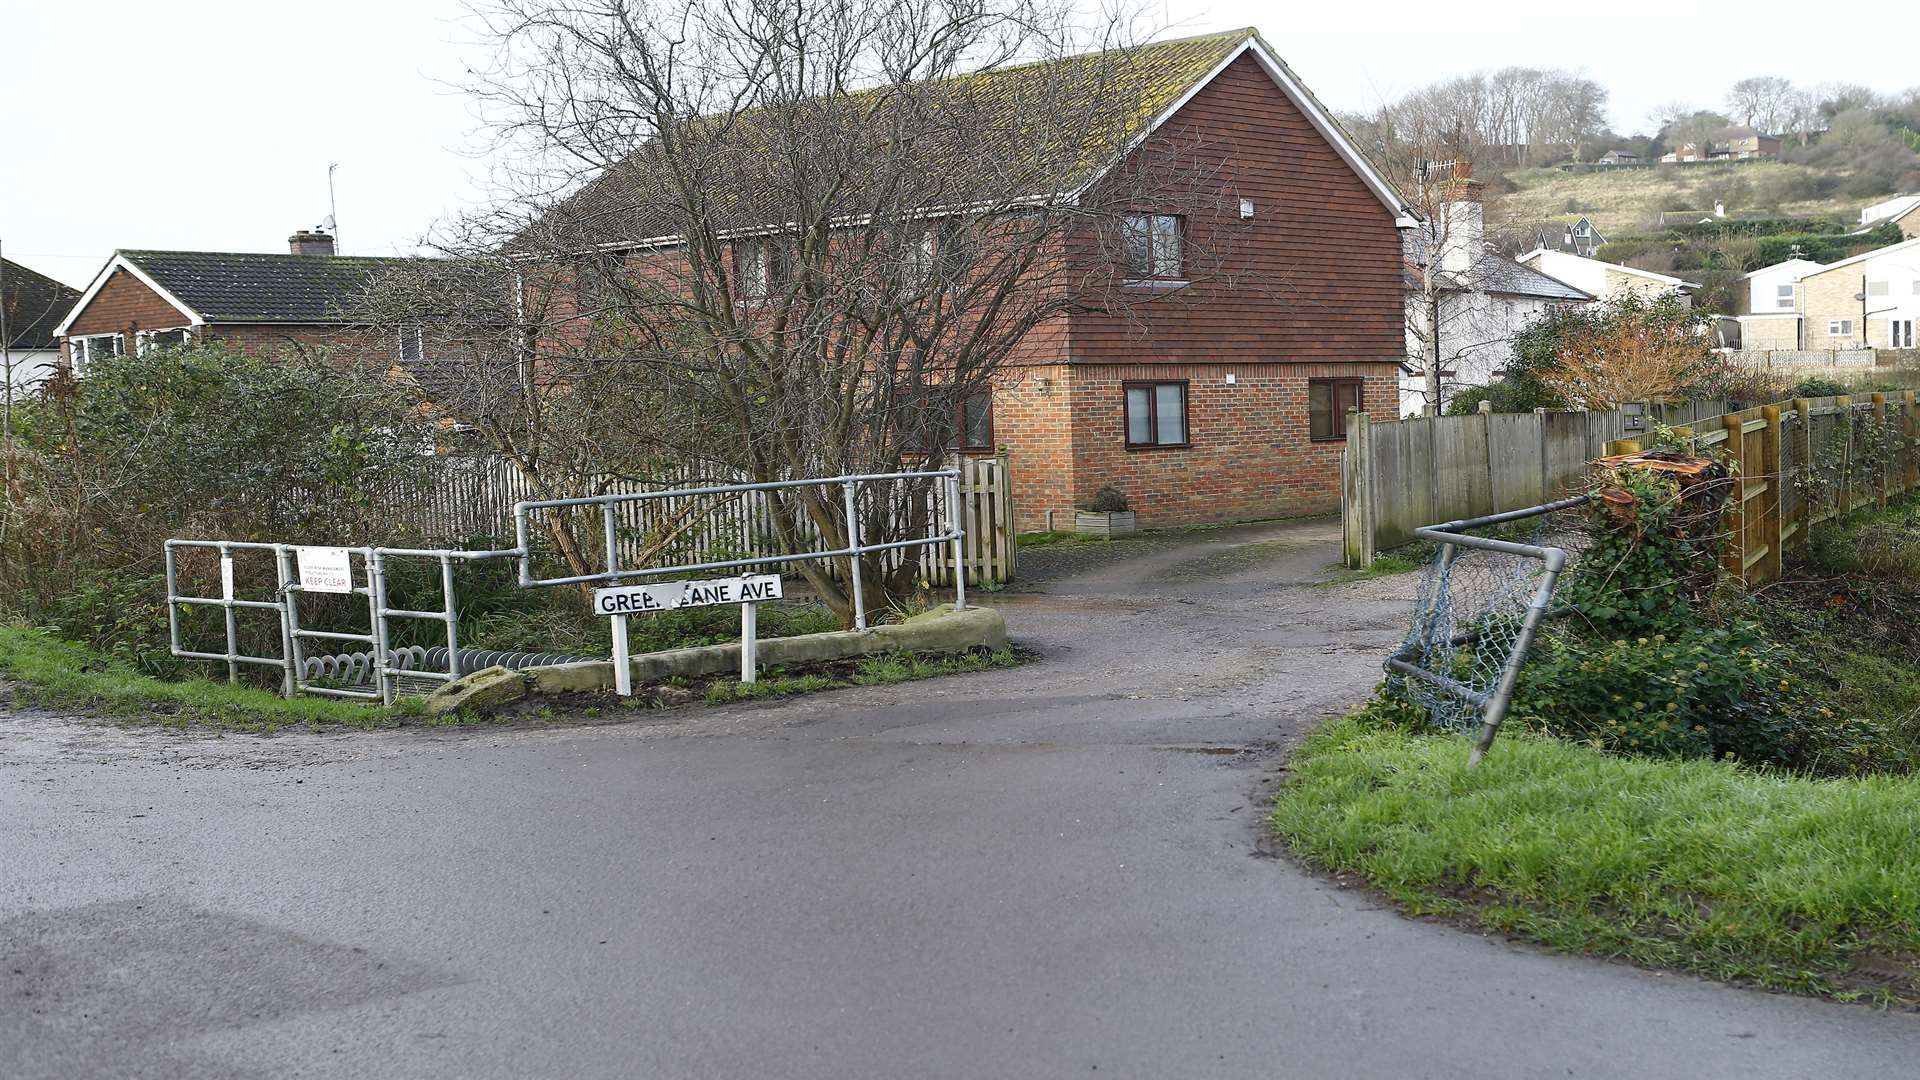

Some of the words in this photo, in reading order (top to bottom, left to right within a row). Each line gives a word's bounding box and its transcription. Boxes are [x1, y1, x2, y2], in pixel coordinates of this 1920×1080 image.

[305, 577, 322, 585] KEEP
[324, 578, 346, 586] CLEAR
[602, 592, 660, 612] GREE
[739, 582, 776, 599] AVE
